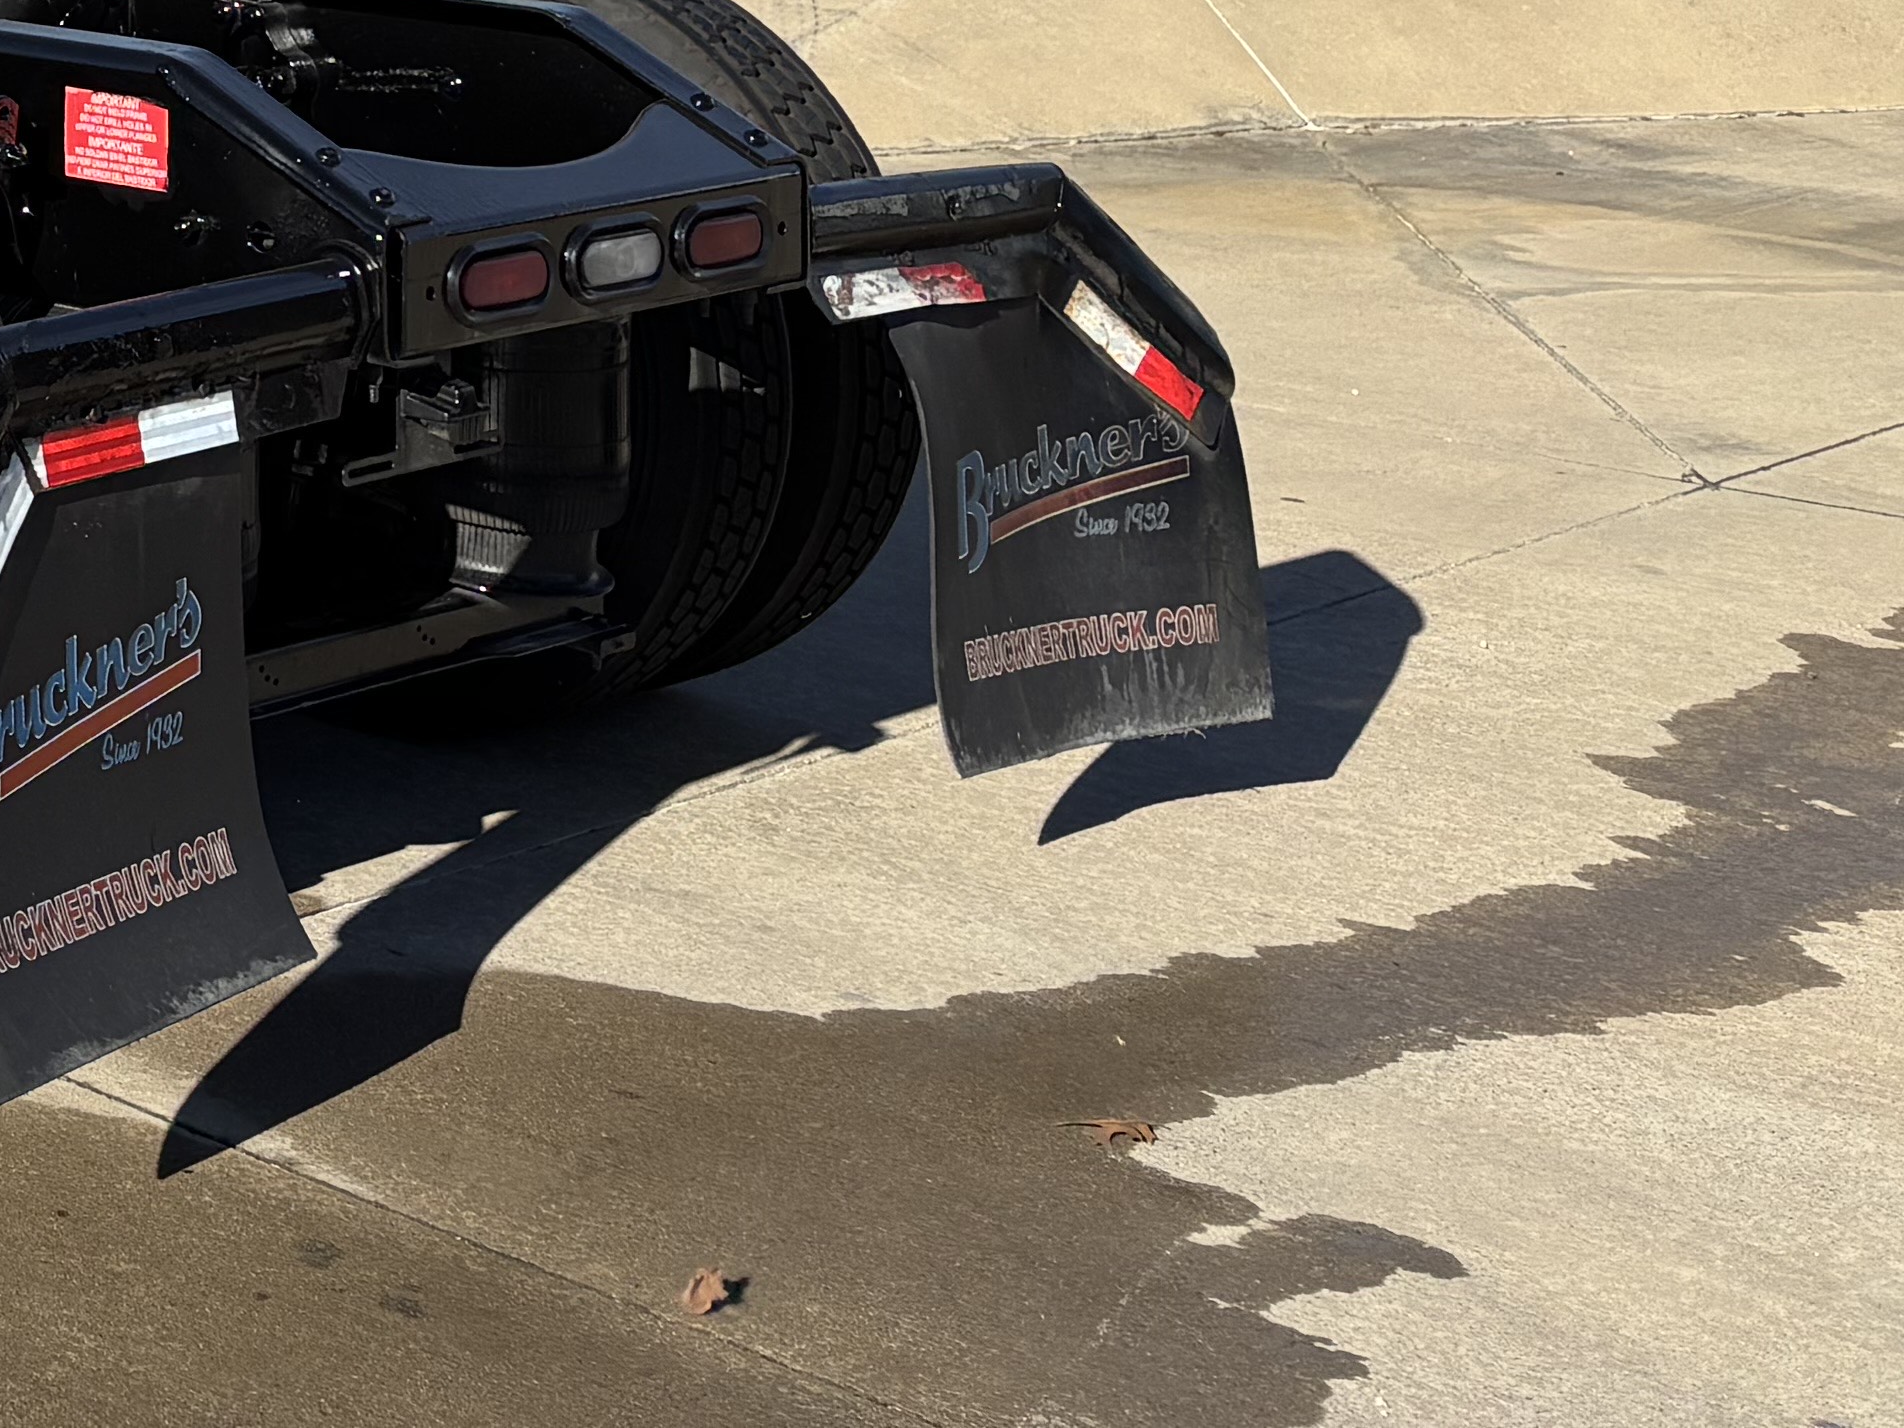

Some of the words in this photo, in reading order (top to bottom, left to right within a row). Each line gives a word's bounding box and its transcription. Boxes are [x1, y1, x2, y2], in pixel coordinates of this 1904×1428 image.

[956, 403, 1189, 575] Bruckner's
[1074, 505, 1119, 538] Since
[1124, 501, 1171, 533] 1932
[964, 604, 1220, 682] BRUCKNERTRUCK.COM
[101, 732, 141, 771] Since
[145, 711, 184, 755] 1932
